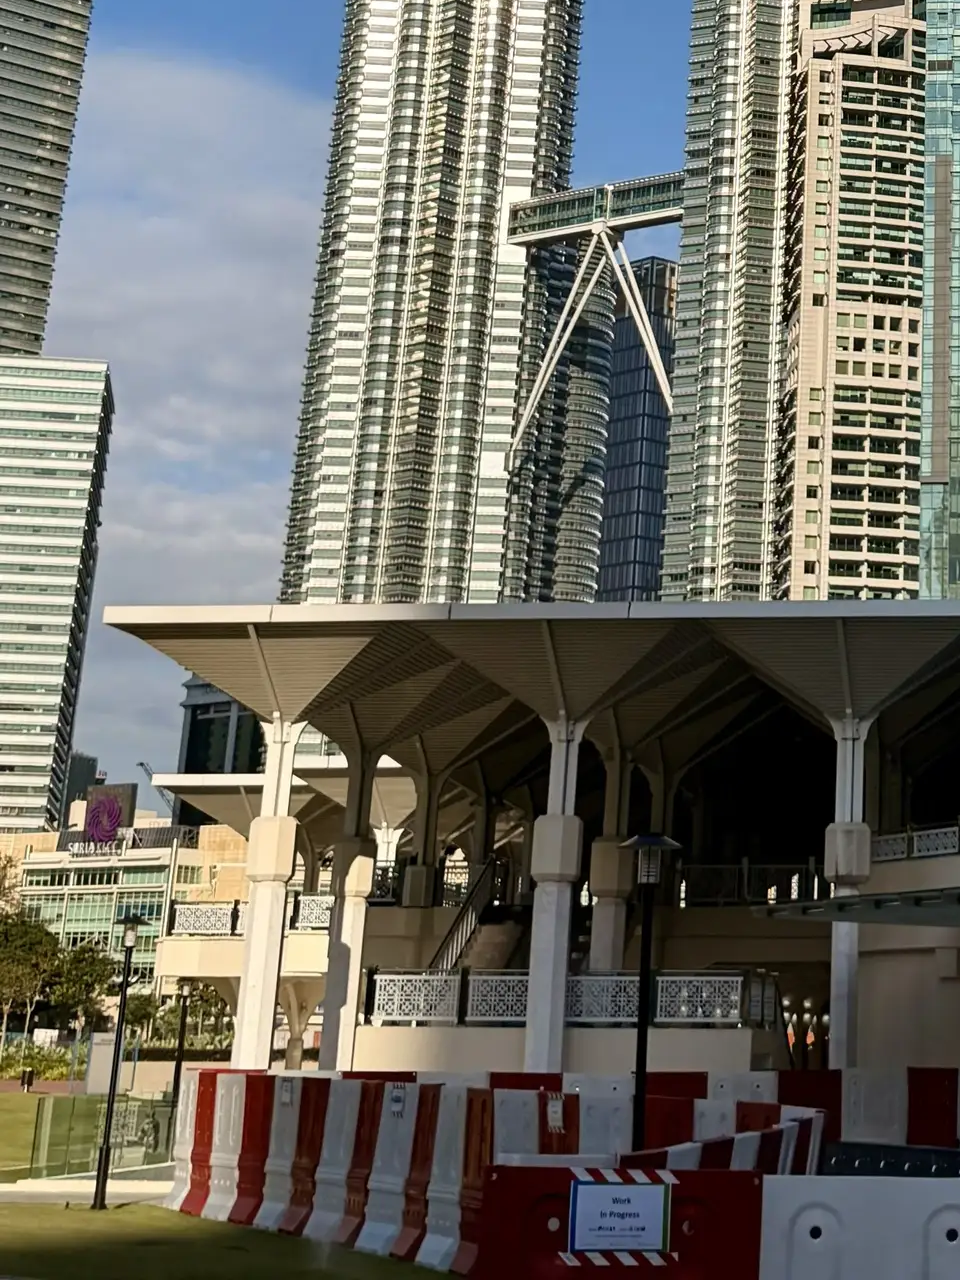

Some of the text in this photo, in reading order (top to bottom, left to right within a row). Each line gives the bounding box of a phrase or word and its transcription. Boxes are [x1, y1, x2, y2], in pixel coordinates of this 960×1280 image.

[68, 842, 95, 854] SURIA
[611, 1197, 632, 1205] Work
[600, 1210, 640, 1220] In Progress
